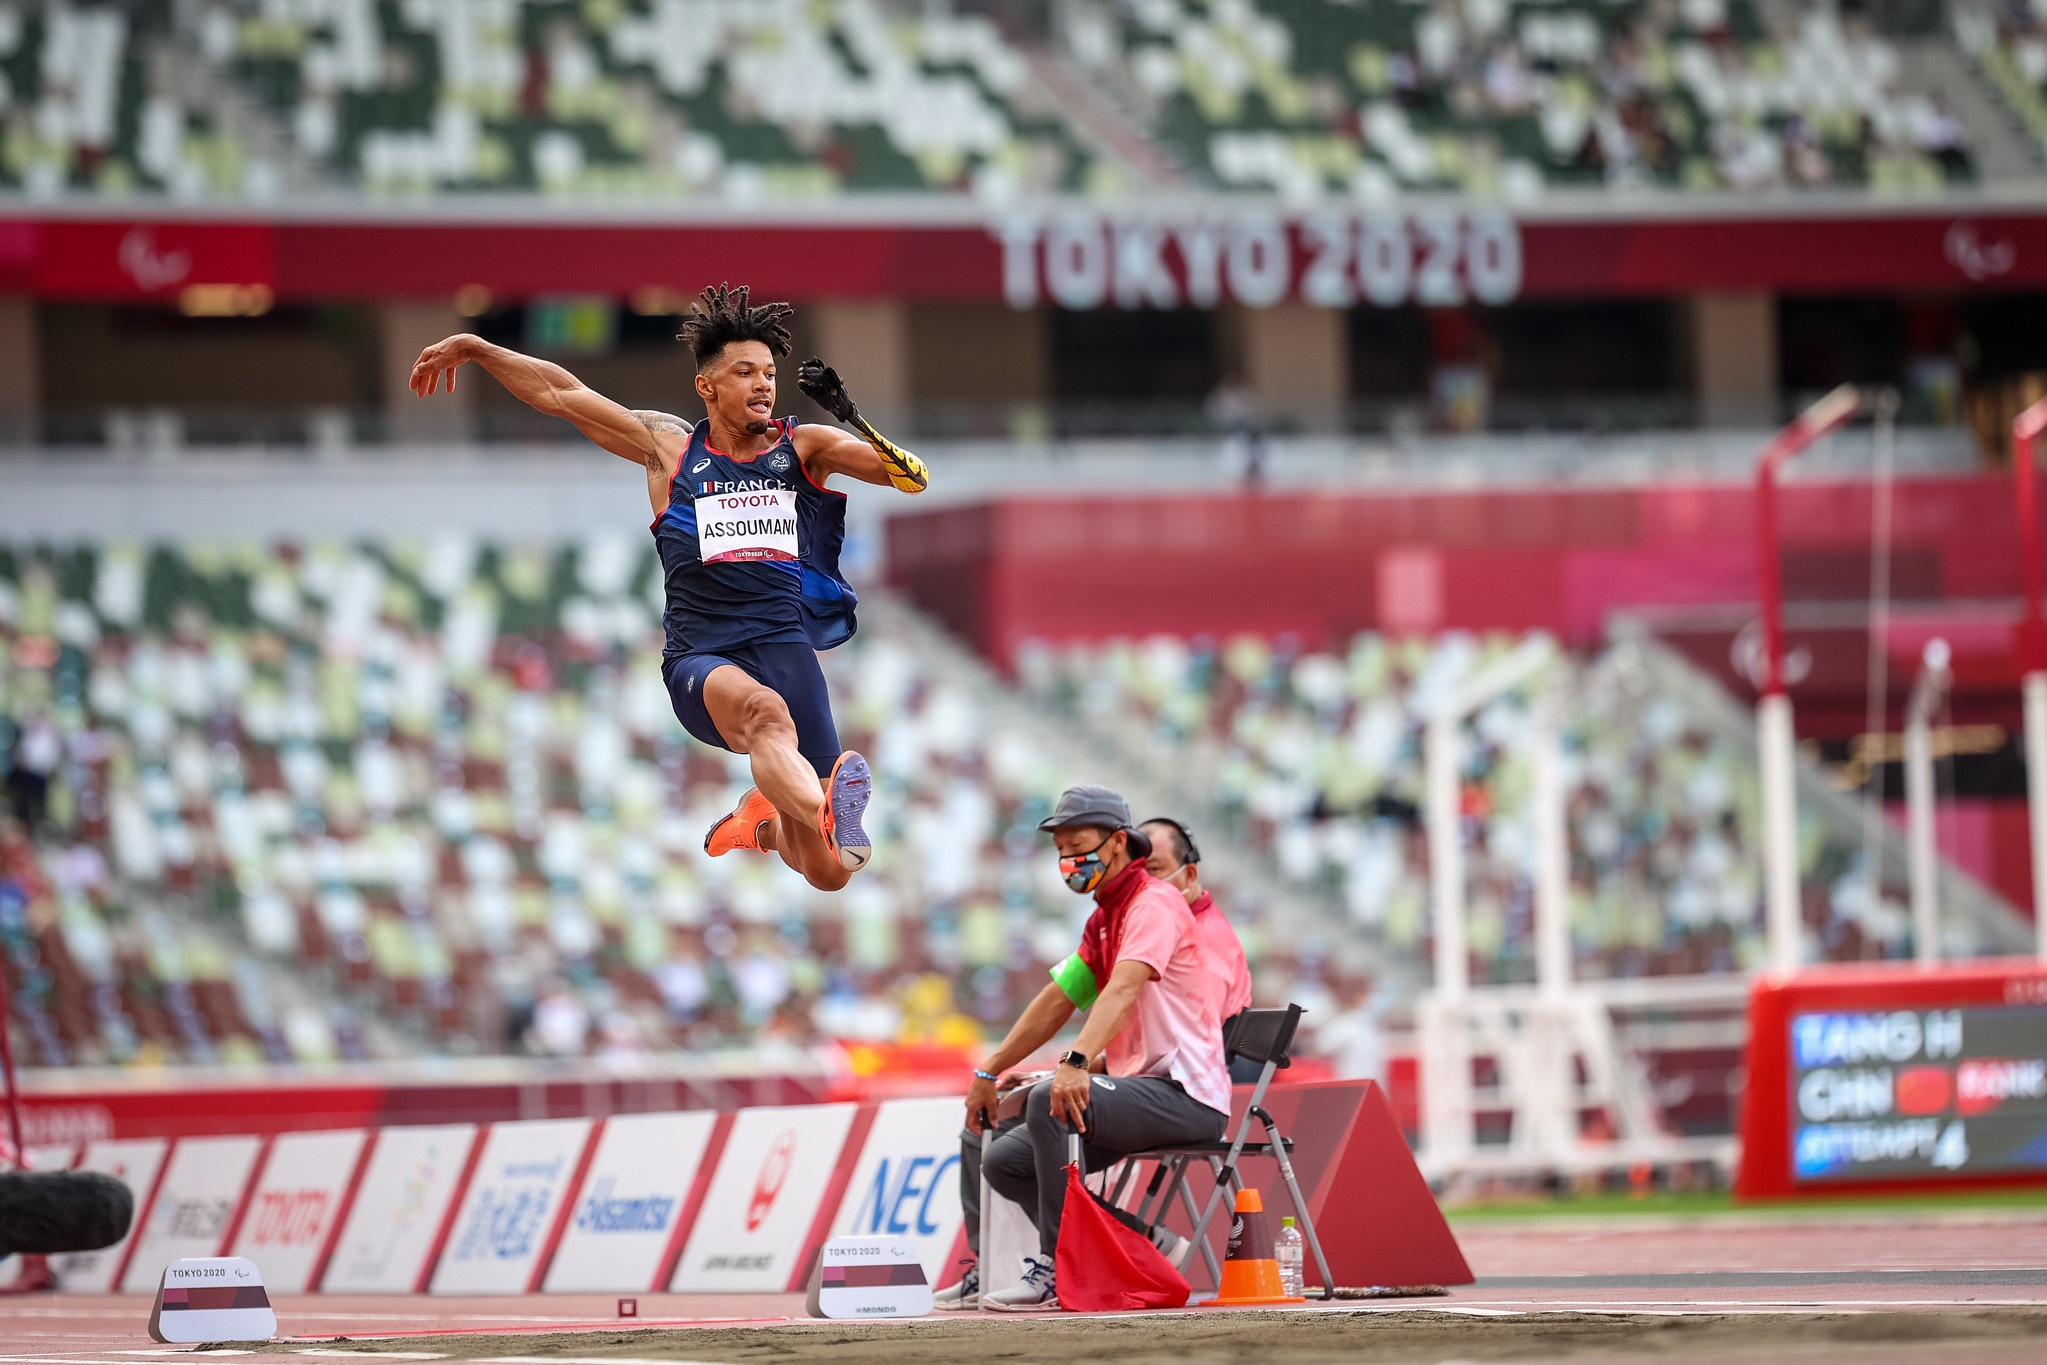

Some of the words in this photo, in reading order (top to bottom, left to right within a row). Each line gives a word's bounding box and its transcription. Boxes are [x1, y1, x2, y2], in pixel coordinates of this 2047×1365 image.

[992, 212, 1288, 308] TOKYO
[1301, 208, 1523, 306] 2020
[714, 479, 787, 493] FRANCE
[718, 495, 779, 509] TOYOTA
[704, 519, 795, 539] ASSOUMANI
[1797, 1012, 1922, 1064] TANG
[1925, 1009, 1963, 1059] H
[1798, 1068, 1893, 1121] CHN
[1931, 1120, 1970, 1170] 4
[852, 1155, 961, 1234] NEC
[859, 1248, 881, 1256] 2020
[173, 1269, 202, 1278] TOKYO
[204, 1268, 226, 1277] 2020
